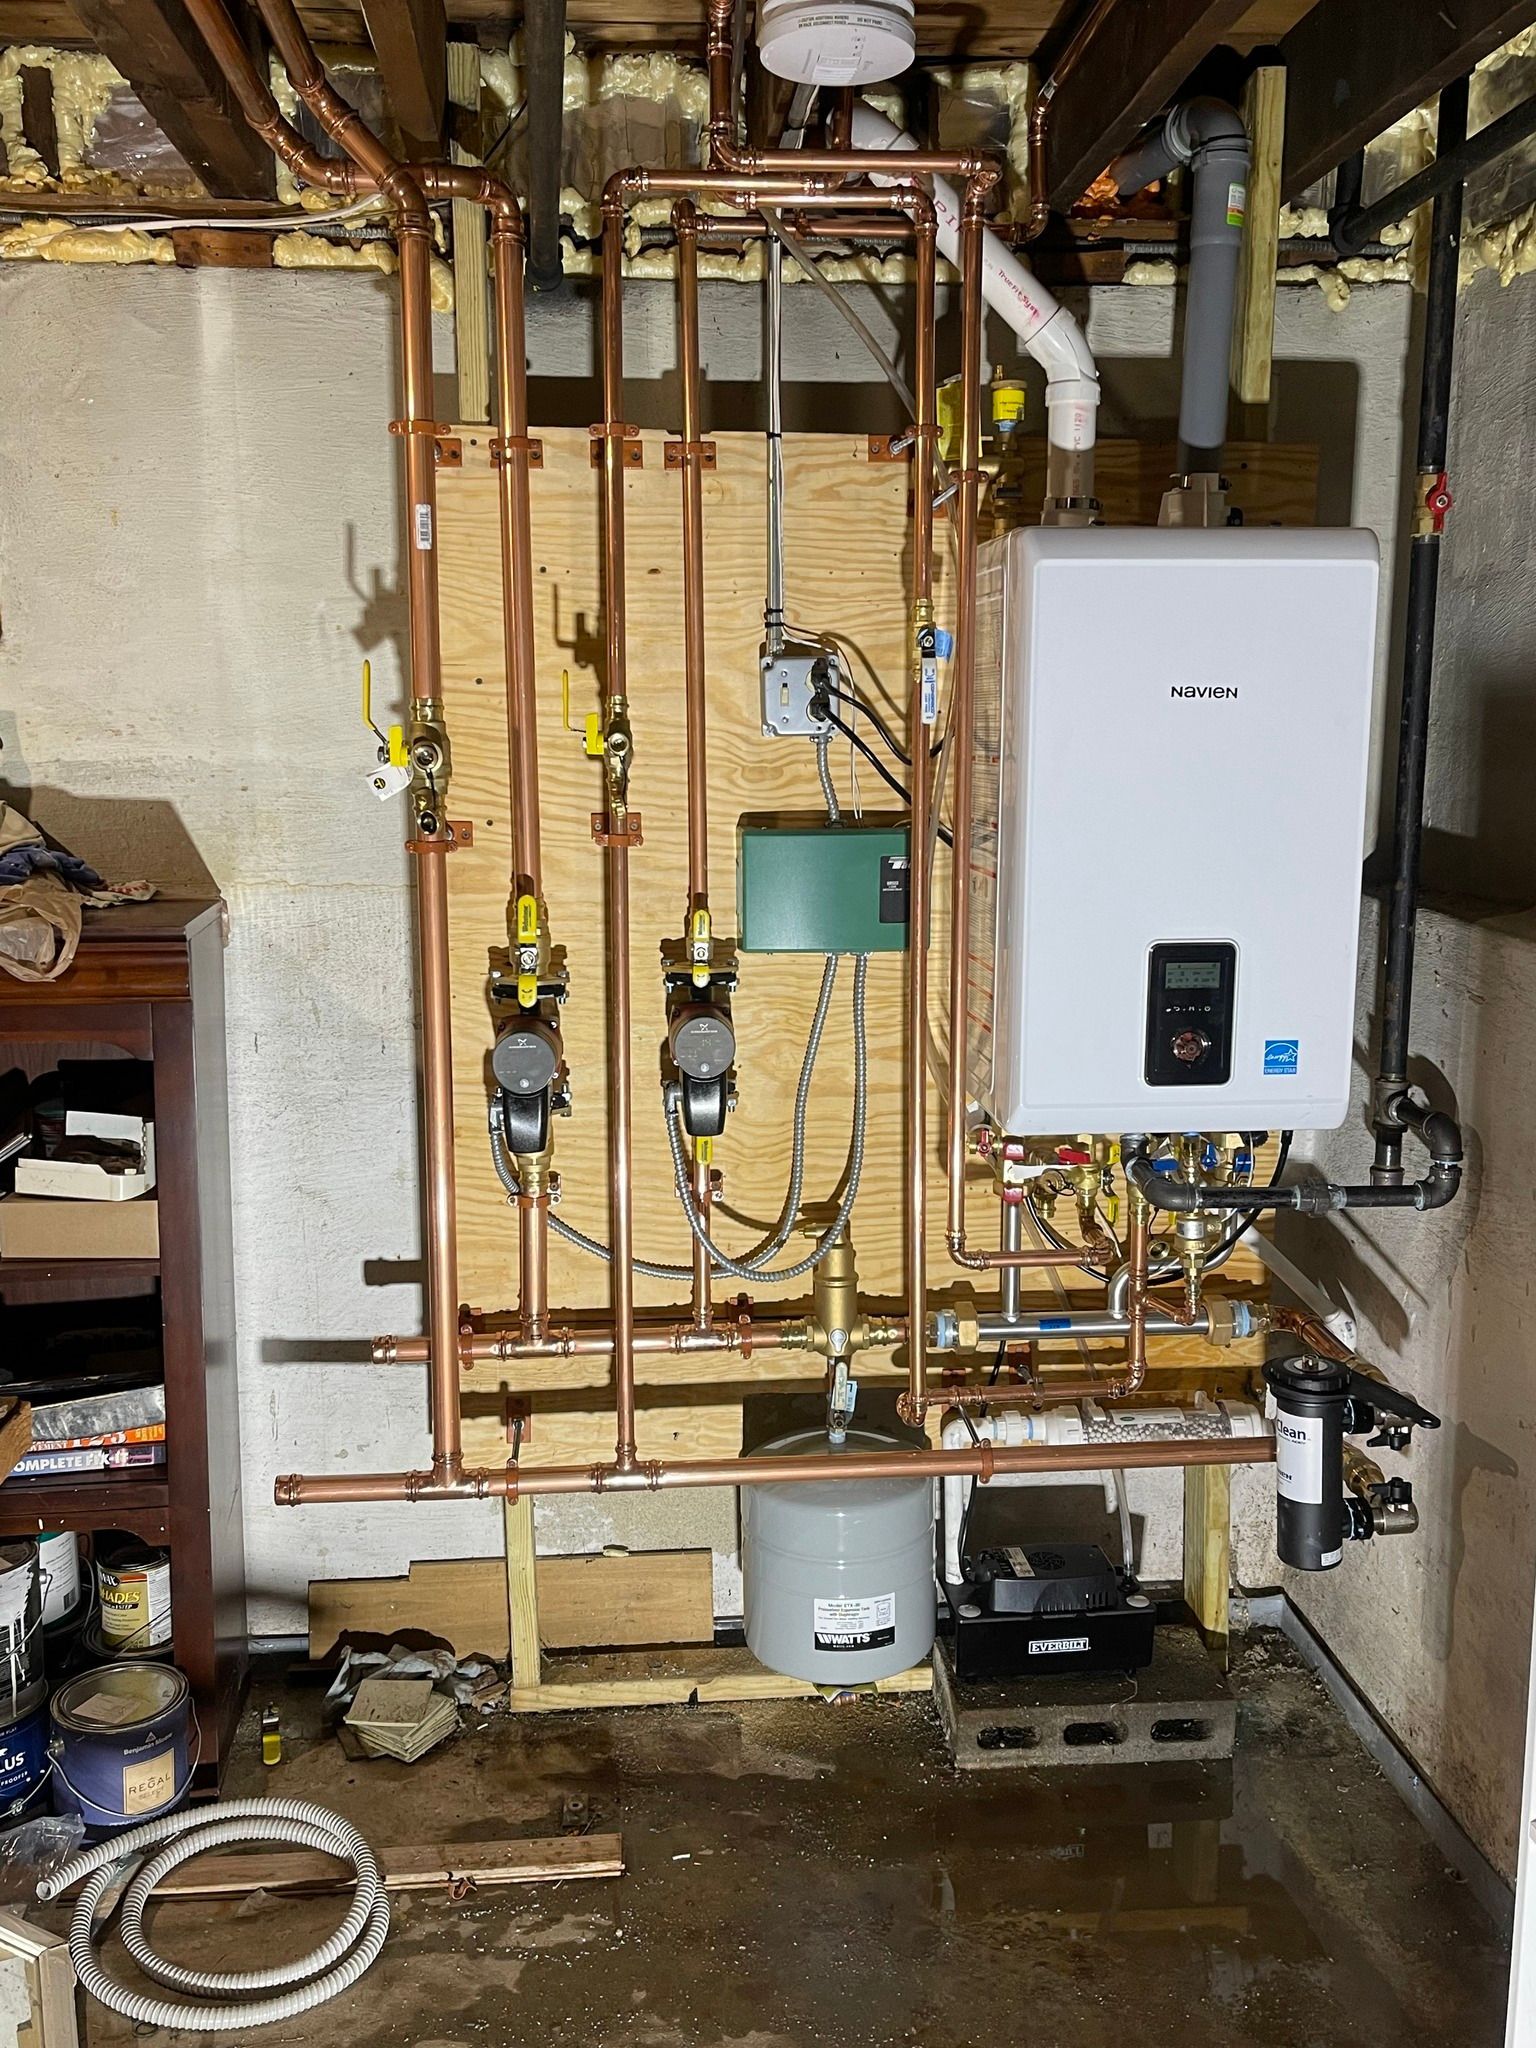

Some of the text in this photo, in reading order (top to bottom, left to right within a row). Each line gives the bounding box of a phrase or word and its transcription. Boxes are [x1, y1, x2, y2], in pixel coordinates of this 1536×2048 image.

[11, 1456, 83, 1473] OMPLETE
[1031, 1640, 1086, 1652] EVERBILT
[128, 1773, 172, 1796] REGAL
